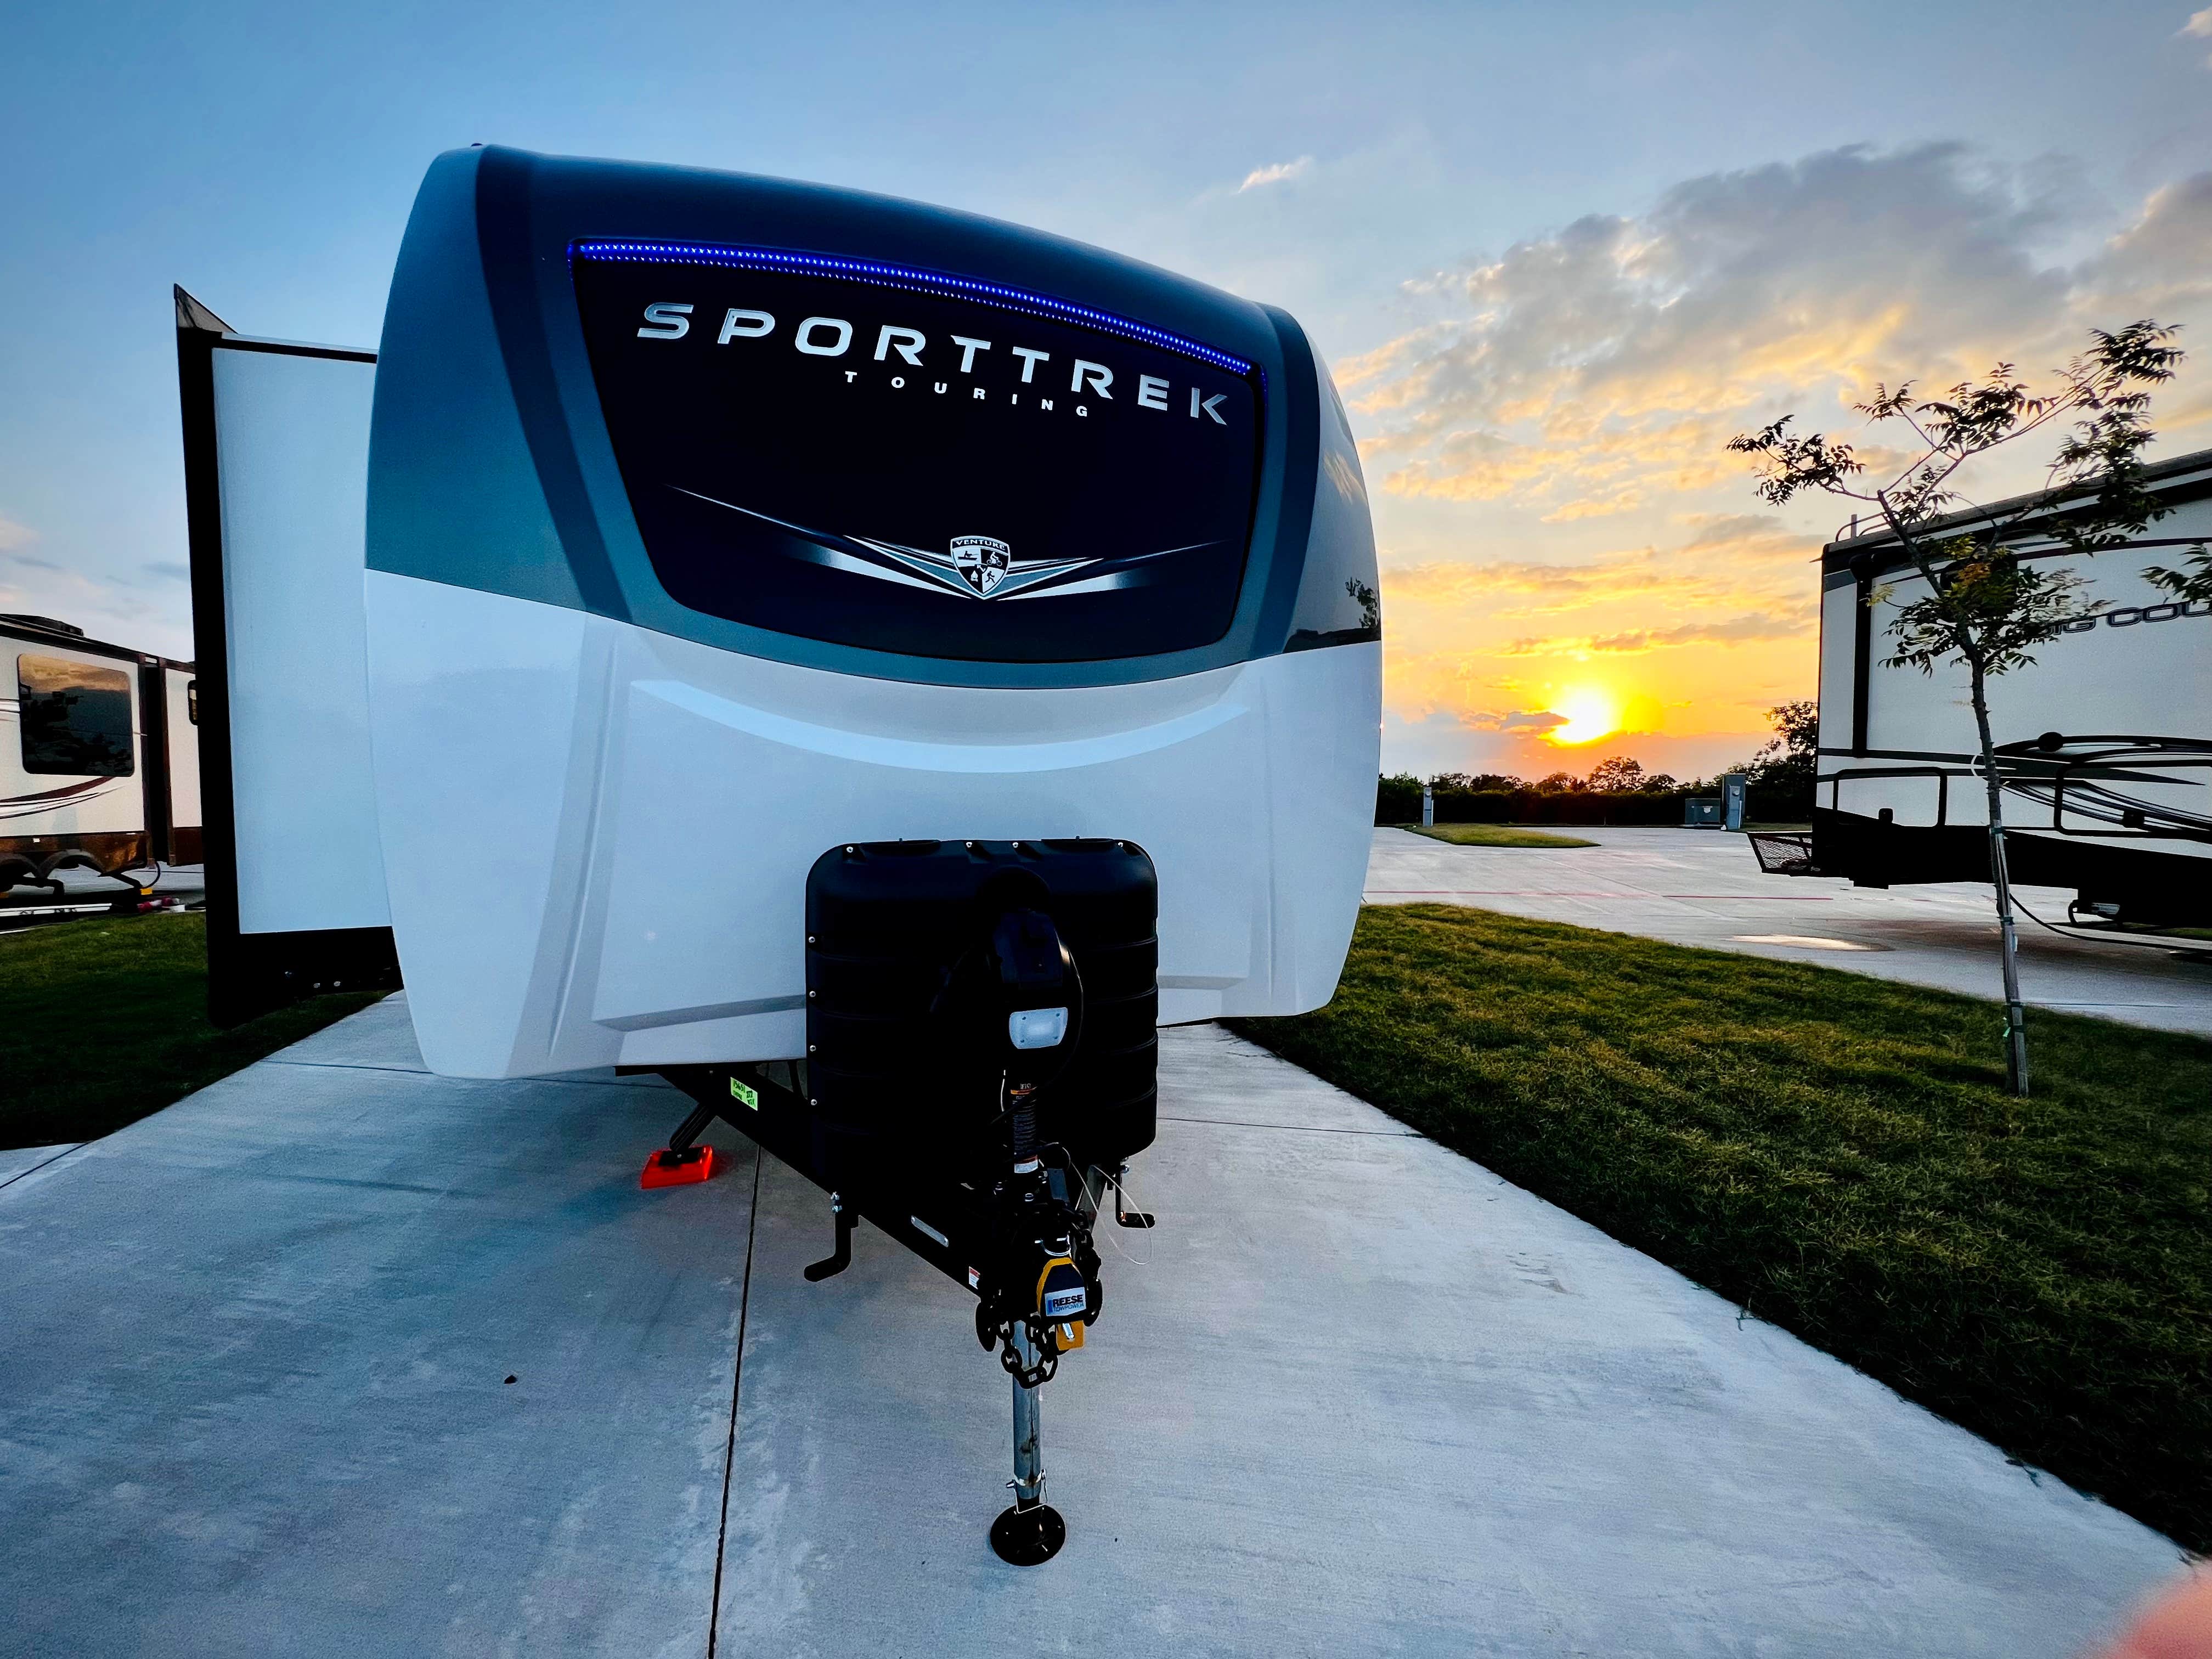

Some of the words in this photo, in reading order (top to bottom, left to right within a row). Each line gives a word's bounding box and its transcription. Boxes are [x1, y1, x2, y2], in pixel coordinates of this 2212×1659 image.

[637, 302, 1228, 426] SPORTTREK
[845, 370, 1088, 417] TOURING
[955, 539, 1006, 551] VENTURE
[1052, 1294, 1084, 1307] REESE
